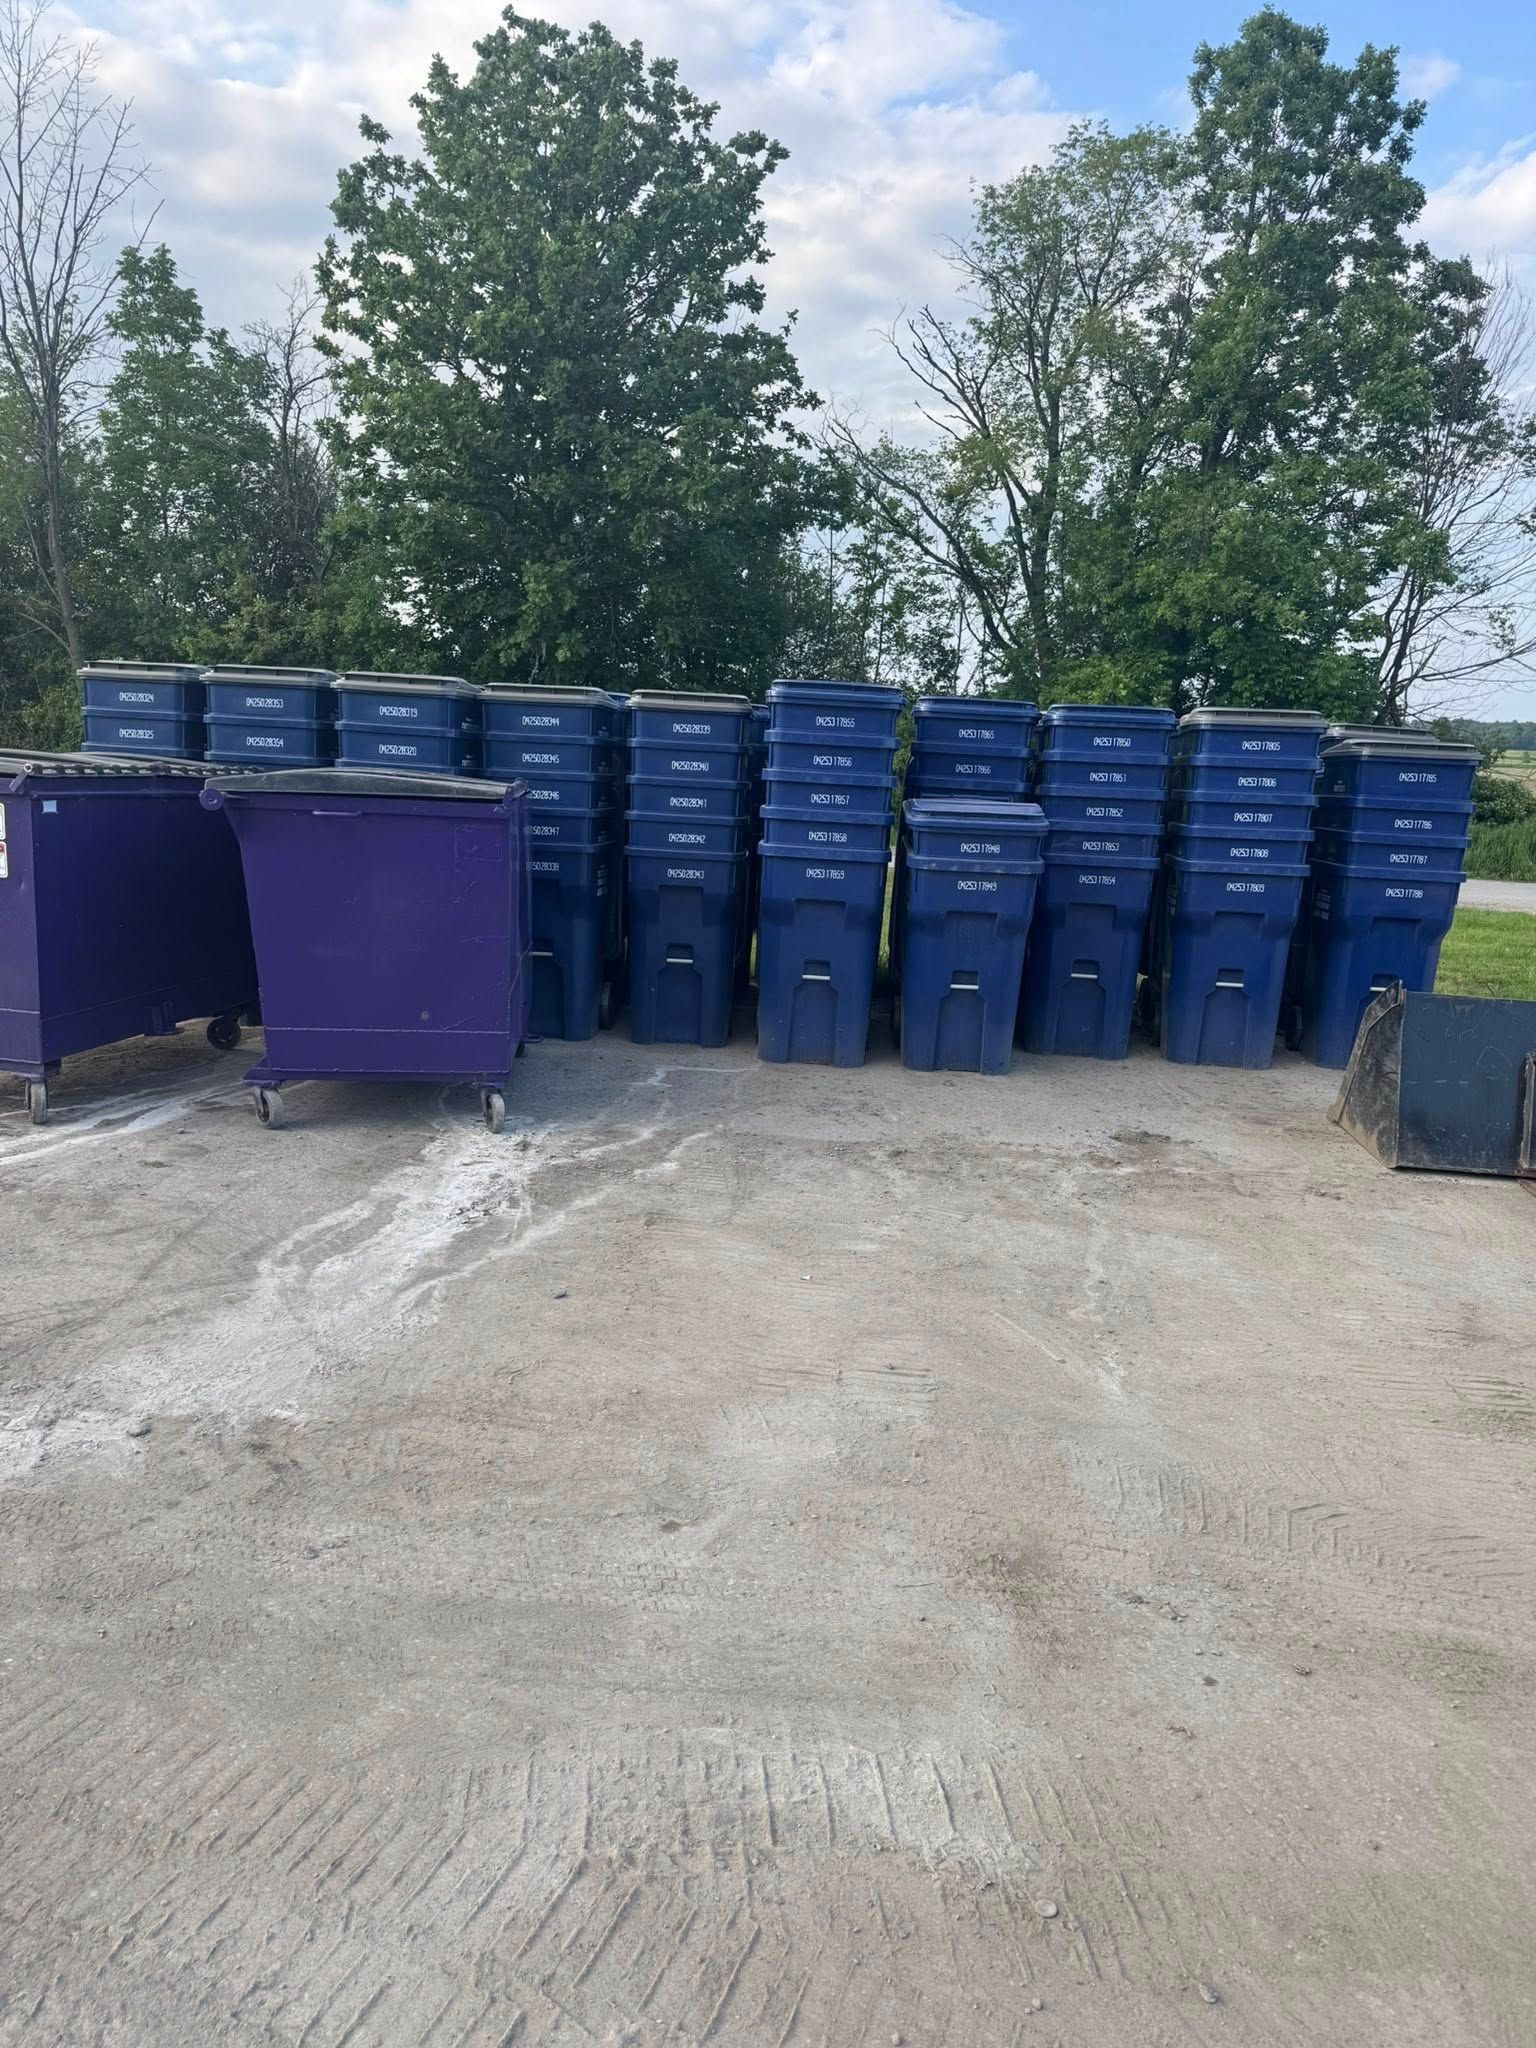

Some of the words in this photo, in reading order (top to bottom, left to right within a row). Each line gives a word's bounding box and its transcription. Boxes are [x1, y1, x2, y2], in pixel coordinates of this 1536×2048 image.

[119, 692, 154, 702] 0425028324
[246, 697, 283, 708] 0425028353
[379, 706, 417, 717] 0425028319
[522, 716, 559, 726] 0425028344
[816, 716, 855, 728] 0425317855
[673, 723, 710, 734] 0425028339
[119, 729, 154, 739] 0425028325
[246, 737, 283, 747] 0425028354
[1094, 737, 1131, 747] 0425317850
[1242, 741, 1280, 751] 0425317805
[379, 744, 416, 756] 0425028320
[522, 753, 559, 763] 0425028345
[813, 755, 852, 766] 0425317856
[672, 761, 709, 771] 0425028340
[1090, 772, 1126, 782] 0425317851
[1238, 777, 1276, 787] 0425317806
[1399, 773, 1437, 782] 0425317785
[528, 790, 560, 800] 5028346
[811, 794, 849, 804] 0425317857
[670, 797, 706, 808] 0425028341
[1086, 807, 1123, 817] 0425317852
[1234, 813, 1272, 822] 0425317807
[1395, 819, 1432, 829] 0425317786
[529, 826, 560, 835] 5028347
[669, 833, 705, 844] 0425028342
[809, 831, 847, 842] 0425317858
[1083, 841, 1119, 851] 0425317853
[1230, 848, 1269, 857] 0425317808
[1390, 854, 1427, 864] 0425317787
[529, 862, 560, 871] 5028338
[667, 869, 704, 879] 0425028343
[806, 868, 844, 879] 0425317859
[1227, 883, 1265, 892] 0425317809
